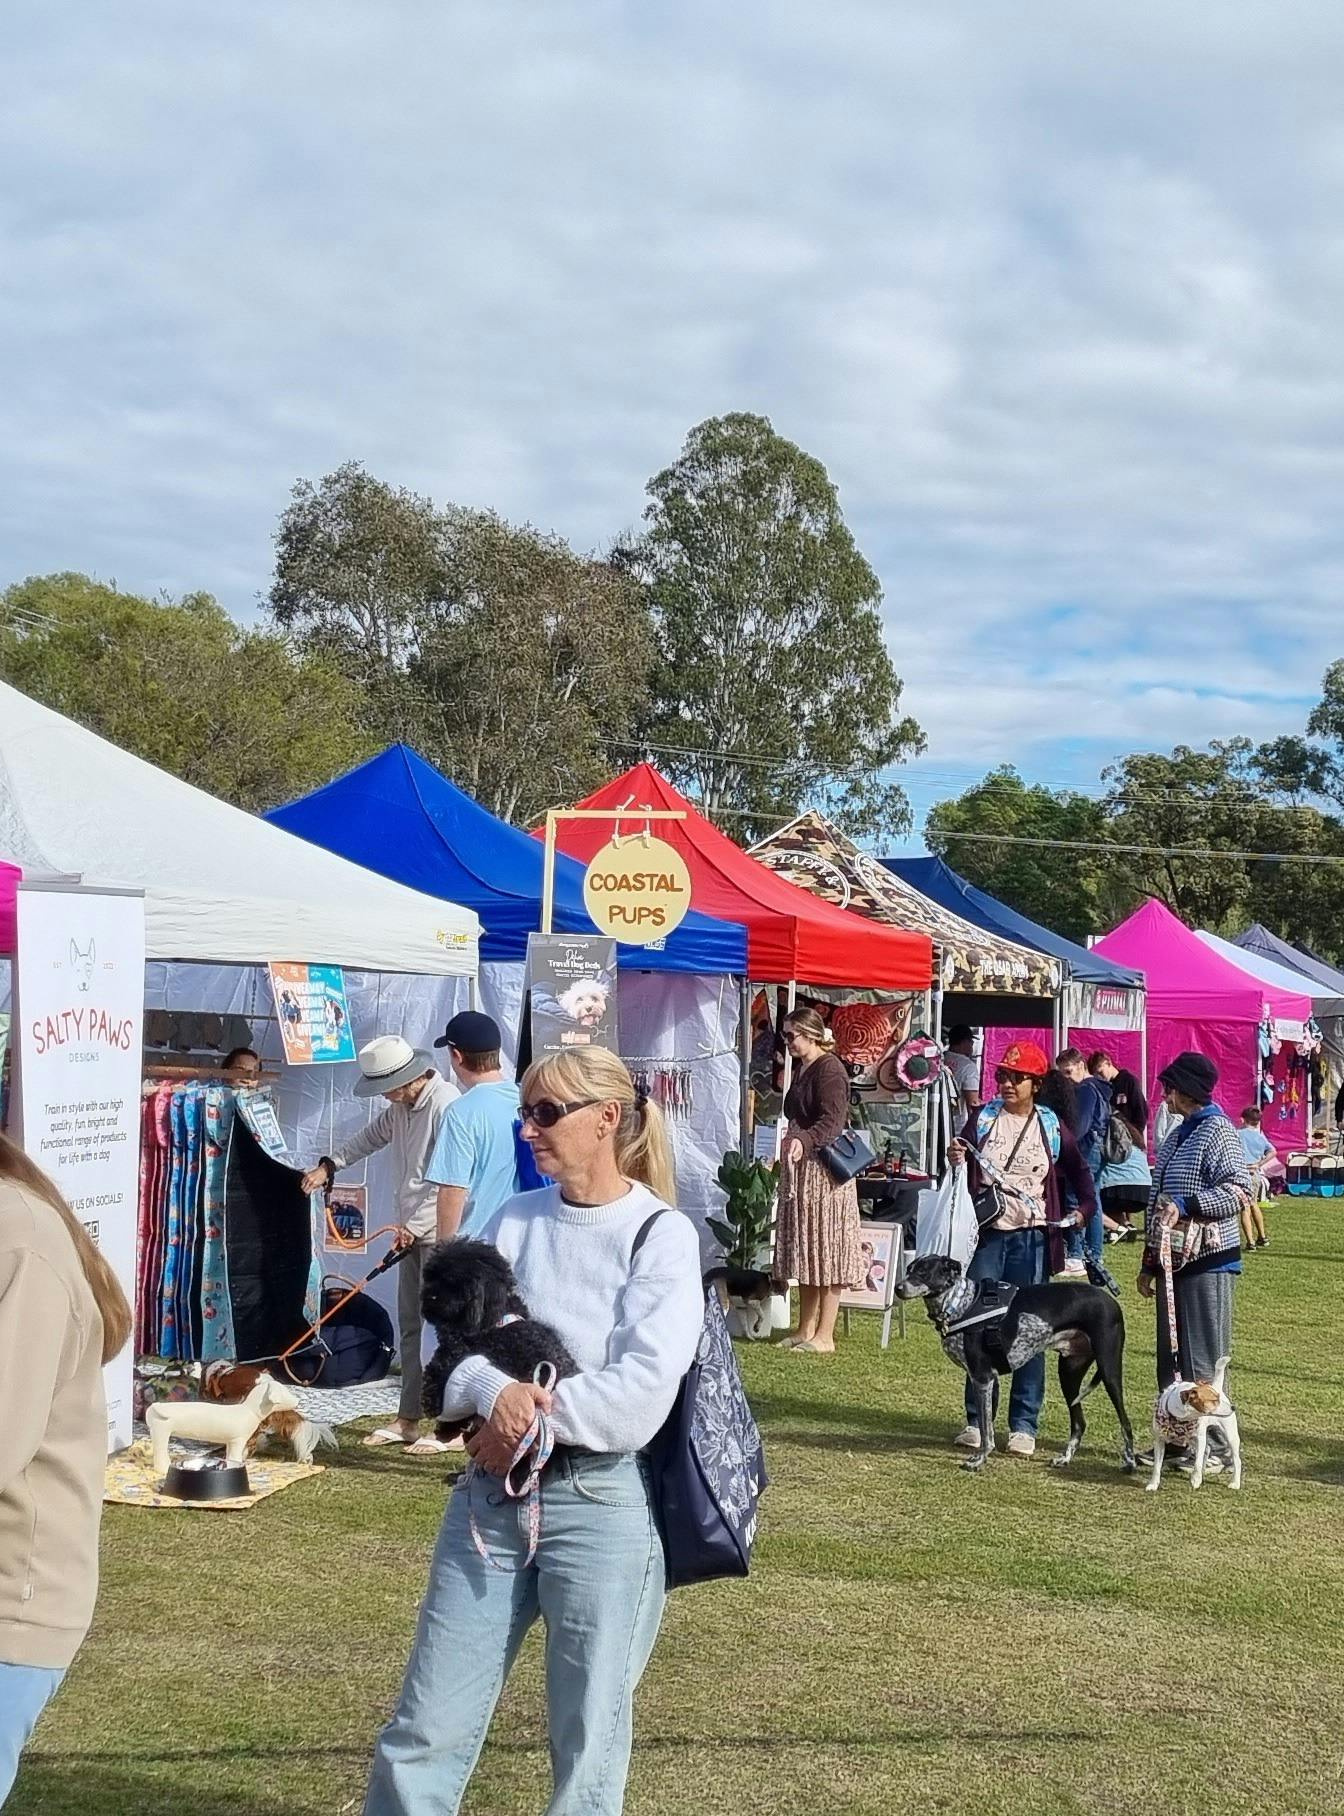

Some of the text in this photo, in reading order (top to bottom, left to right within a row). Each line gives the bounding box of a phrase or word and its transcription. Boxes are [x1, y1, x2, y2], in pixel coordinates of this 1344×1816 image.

[589, 873, 683, 892] COASTAL
[608, 905, 666, 926] PUPS
[32, 1008, 133, 1054] SALTY PAWS
[69, 1052, 100, 1063] DESIGNS
[44, 1098, 124, 1115] Train in style with our high
[87, 1117, 106, 1131] bright
[106, 1115, 119, 1126] and
[40, 1130, 128, 1152] functional range of products
[58, 1153, 68, 1167] for
[69, 1152, 80, 1166] life
[81, 1151, 93, 1162] with
[99, 1149, 111, 1163] dog
[999, 1152, 1031, 1165] DGS
[75, 1198, 85, 1210] US
[85, 1197, 95, 1209] ON
[95, 1192, 124, 1207] SOCIALS!
